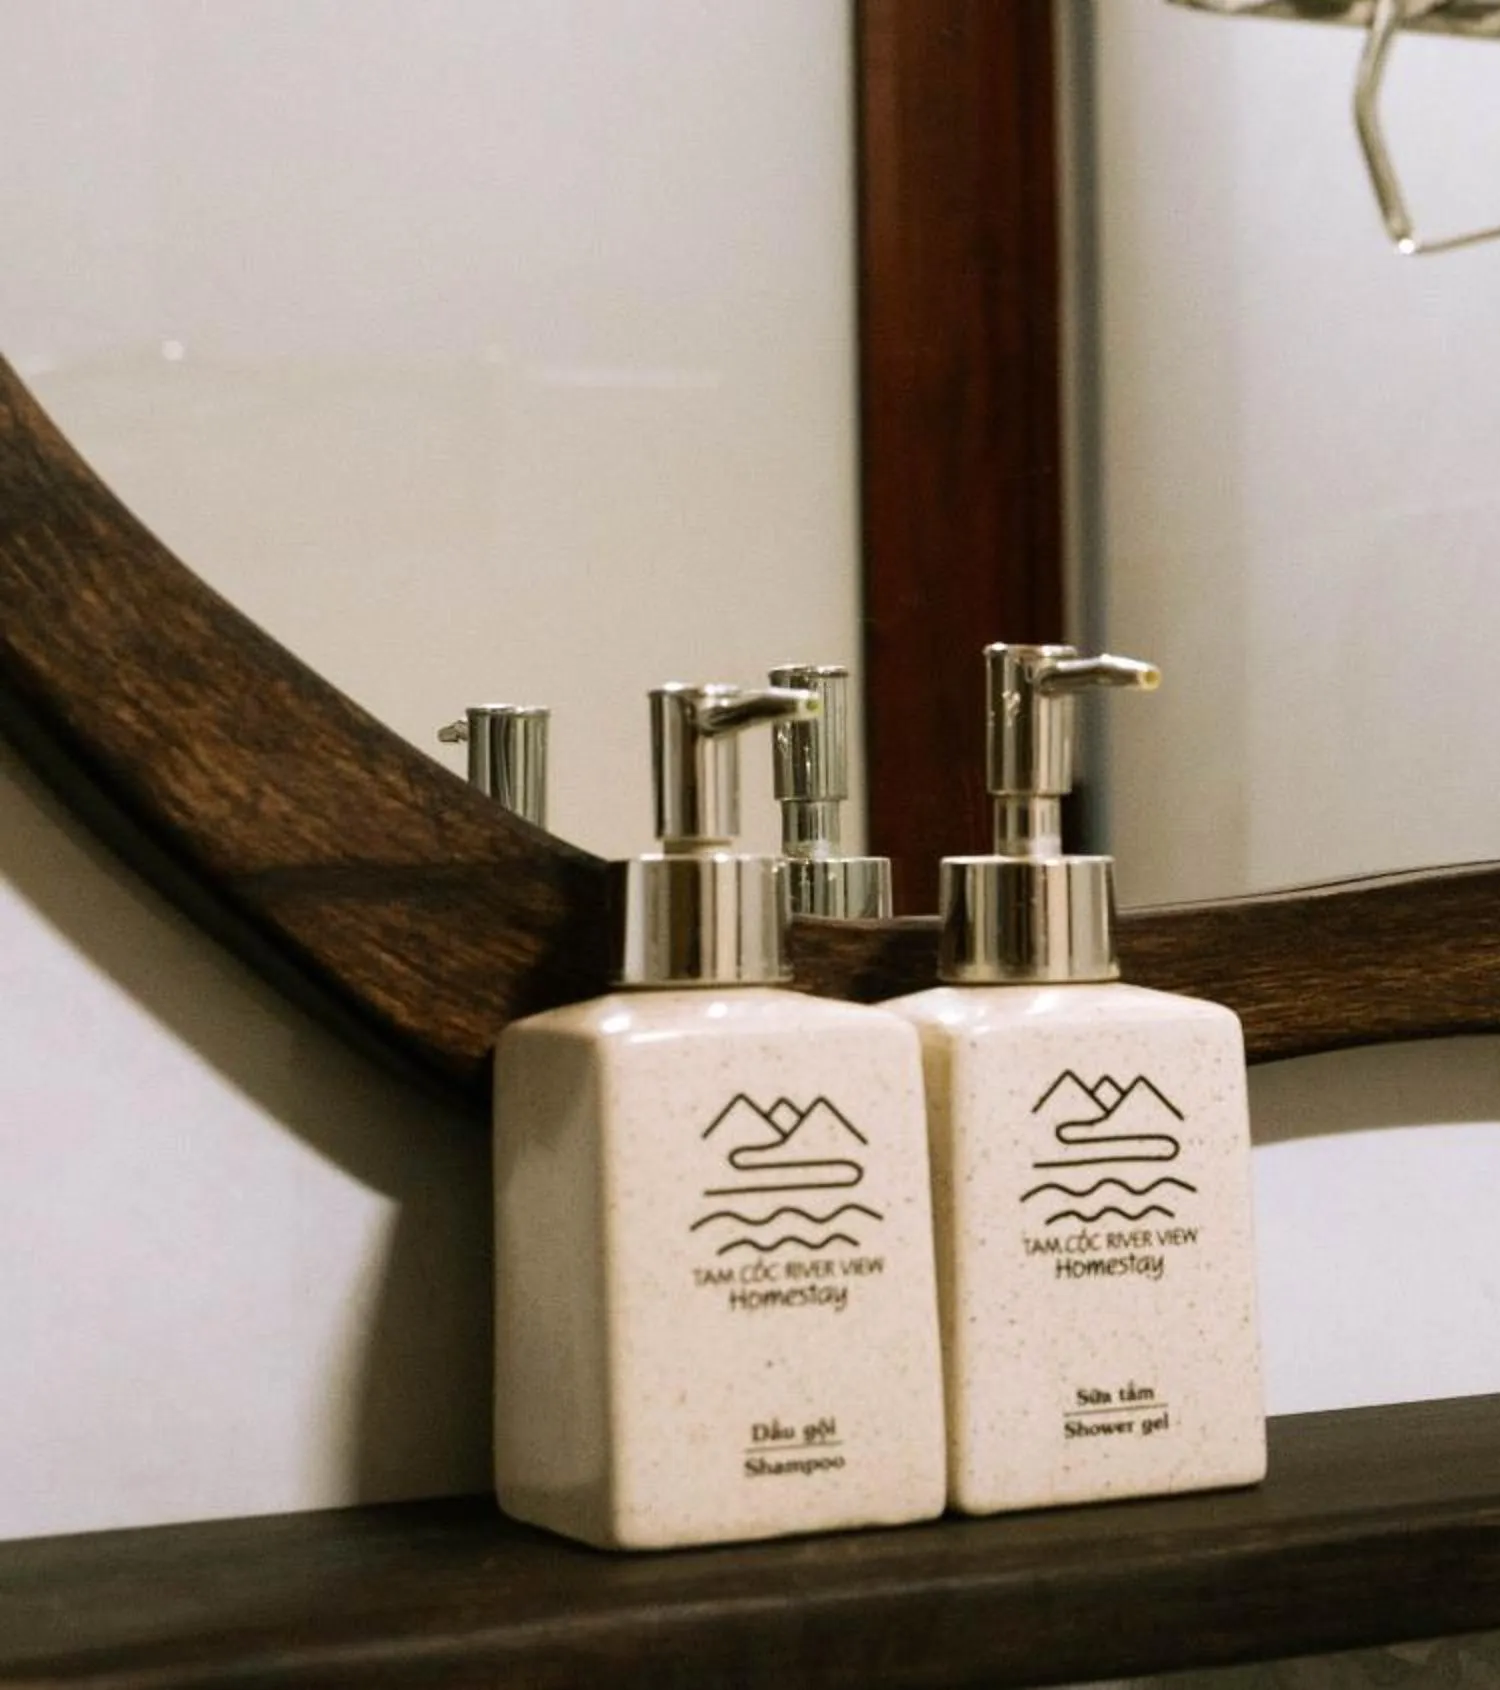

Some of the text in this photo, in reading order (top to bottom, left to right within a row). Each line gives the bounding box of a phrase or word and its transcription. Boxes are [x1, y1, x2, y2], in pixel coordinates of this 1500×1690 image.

[1023, 1237, 1063, 1254] TAM
[1106, 1231, 1153, 1249] RIVER
[1156, 1228, 1199, 1246] VIEW
[693, 1267, 735, 1286] TAM
[784, 1259, 835, 1279] RIVER
[839, 1257, 885, 1276] VIEW
[1055, 1252, 1165, 1281] Homestay
[730, 1284, 849, 1312] Homestay
[1063, 1411, 1169, 1439] Shower gel
[743, 1454, 846, 1477] Shampoo
